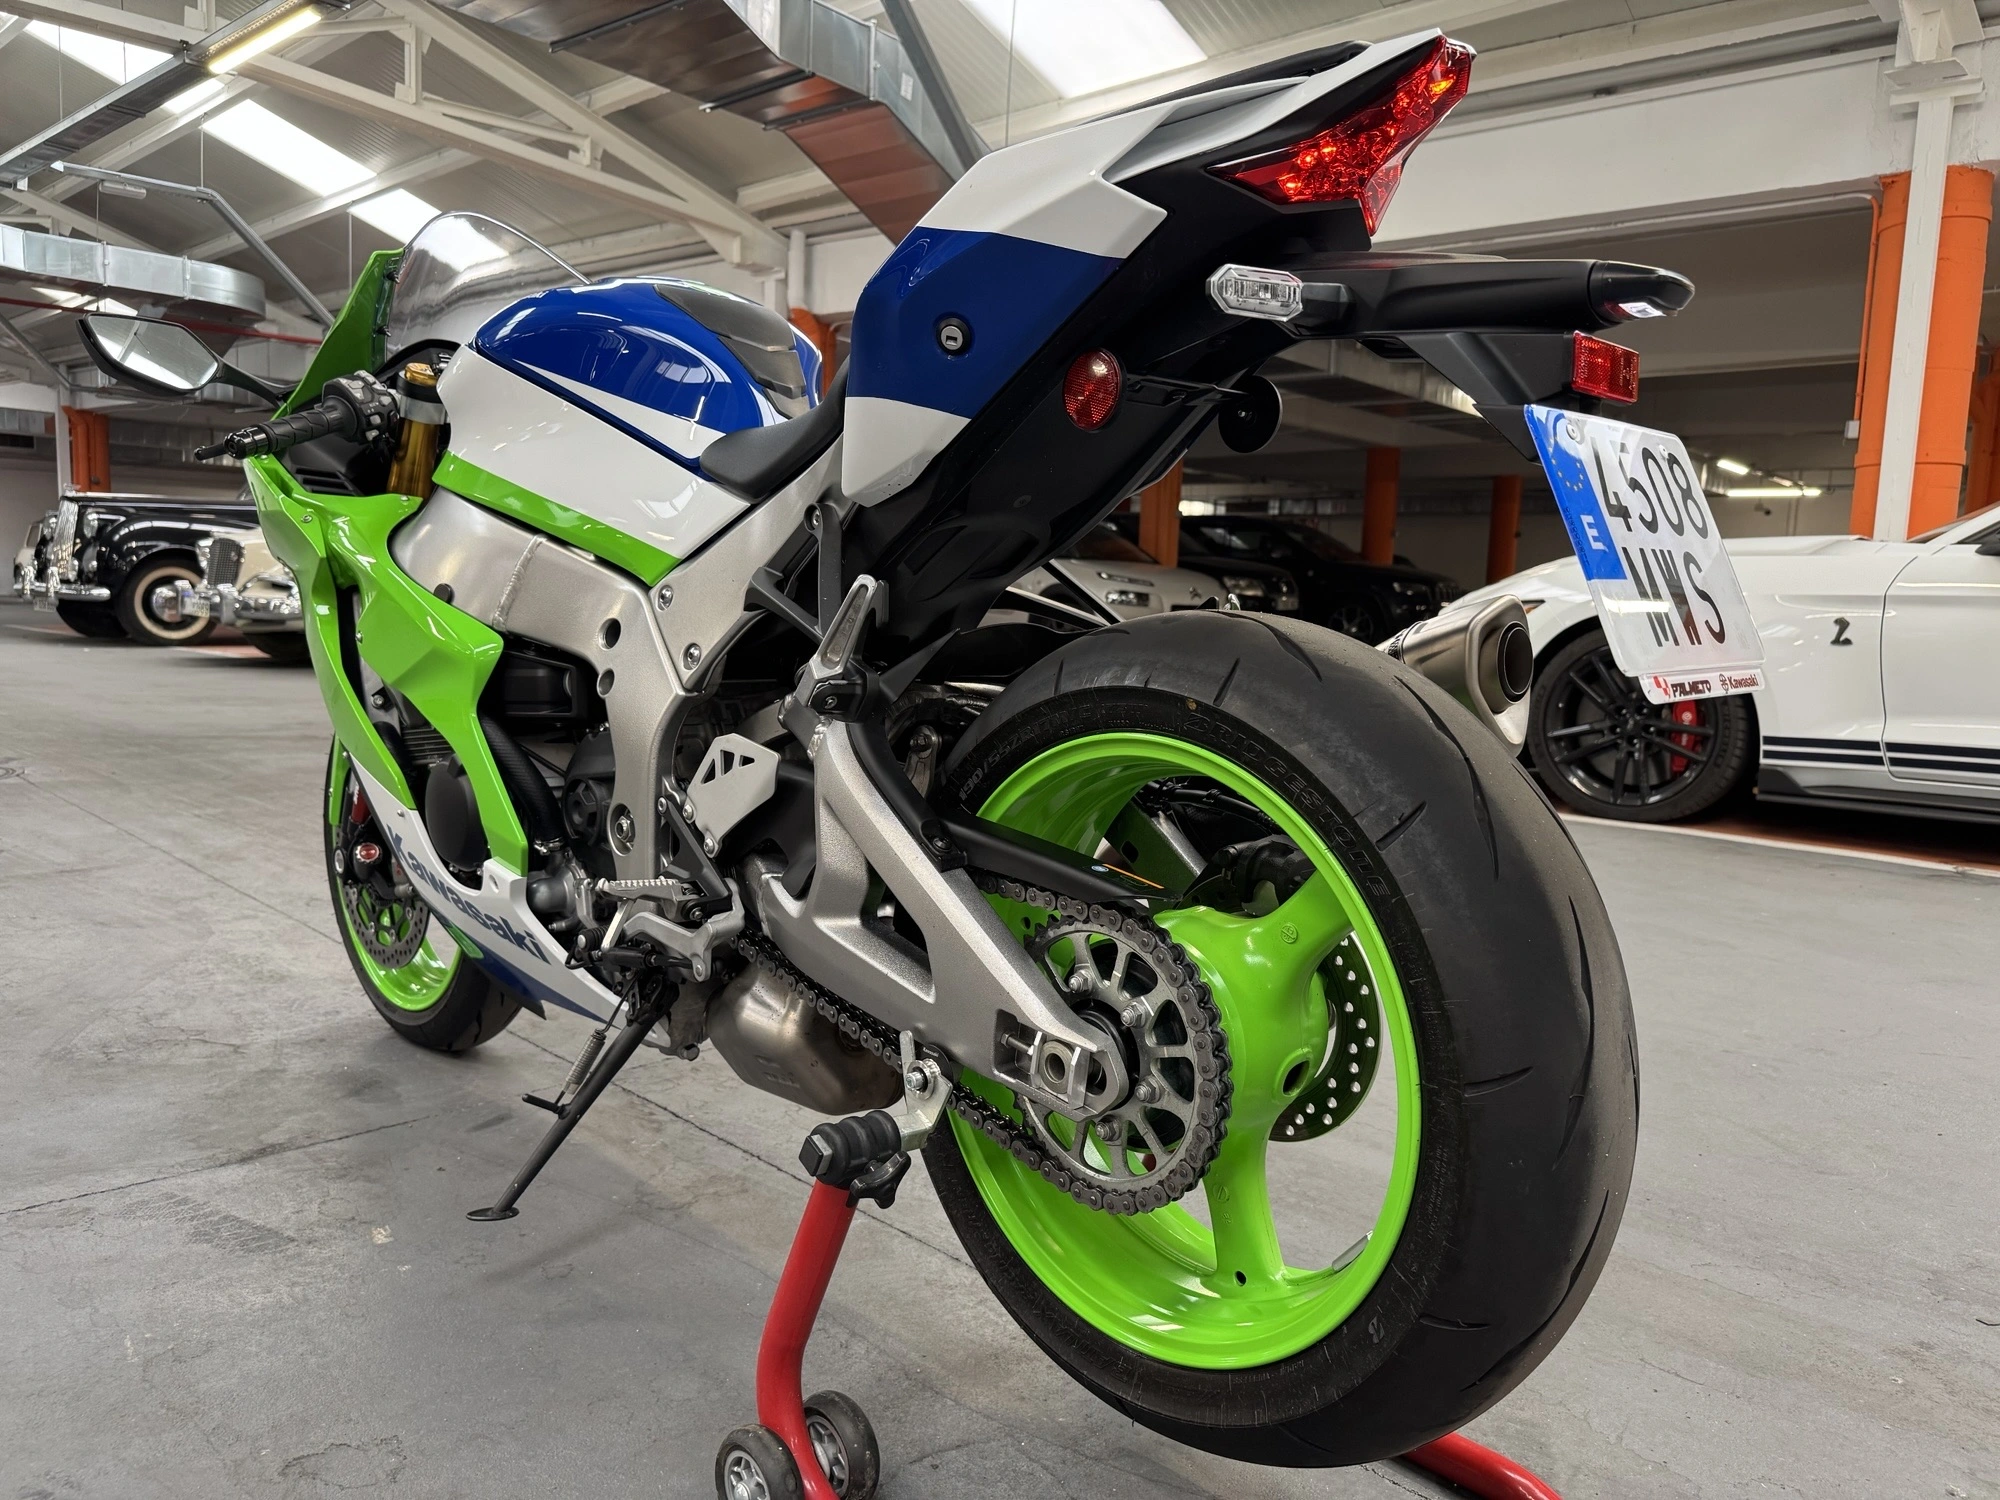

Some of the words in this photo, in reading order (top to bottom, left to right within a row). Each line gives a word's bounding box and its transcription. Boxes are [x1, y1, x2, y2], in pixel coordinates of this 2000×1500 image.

[1580, 514, 1606, 550] E
[1590, 435, 1708, 539] 4508
[1621, 546, 1726, 647] MWS
[1727, 674, 1759, 690] Kawasaki
[1183, 712, 1391, 897] BRIDGESTONE
[386, 824, 552, 965] Kawasaki
